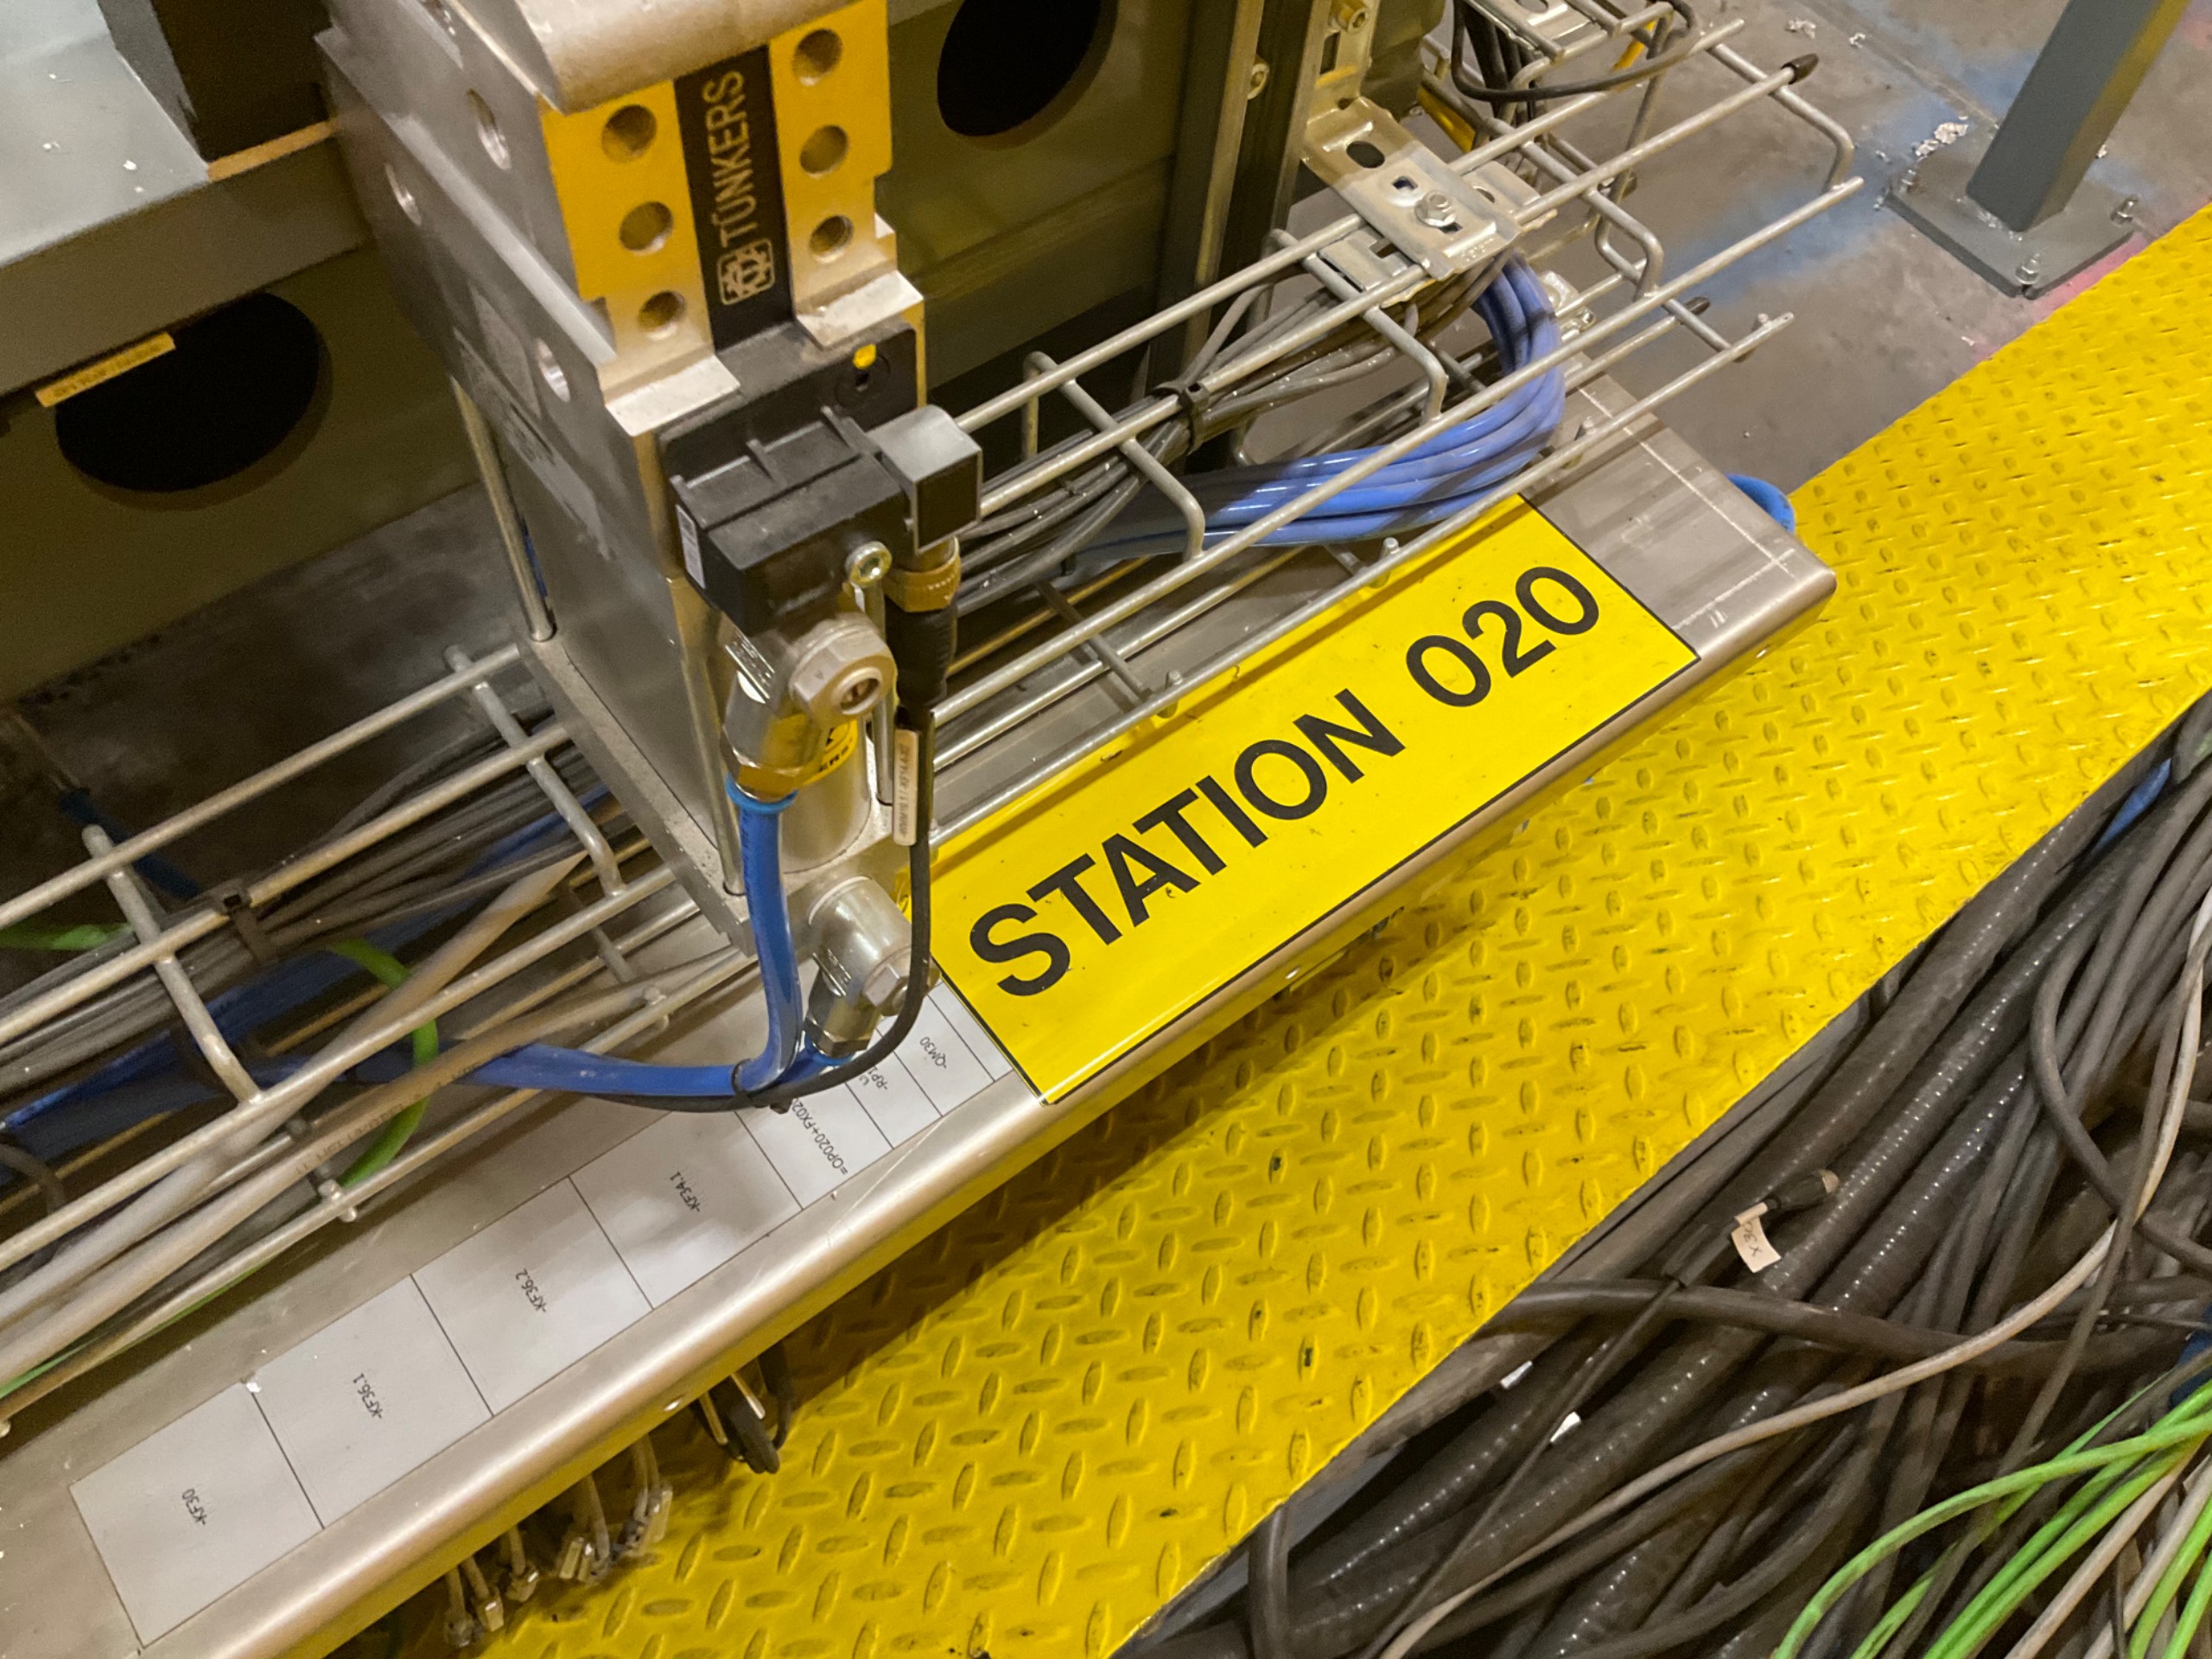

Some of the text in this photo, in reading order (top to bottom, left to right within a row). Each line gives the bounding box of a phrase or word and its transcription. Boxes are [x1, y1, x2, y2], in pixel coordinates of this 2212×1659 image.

[702, 70, 759, 248] TÜNKERS
[970, 689, 1406, 996] STATION
[1406, 567, 1599, 707] 020
[919, 1036, 948, 1070] -QM30
[670, 1171, 701, 1213] -KF34.1
[515, 1268, 547, 1313] -KF36.2
[353, 1372, 383, 1420] -KF36.1
[181, 1488, 207, 1526] -KF30
